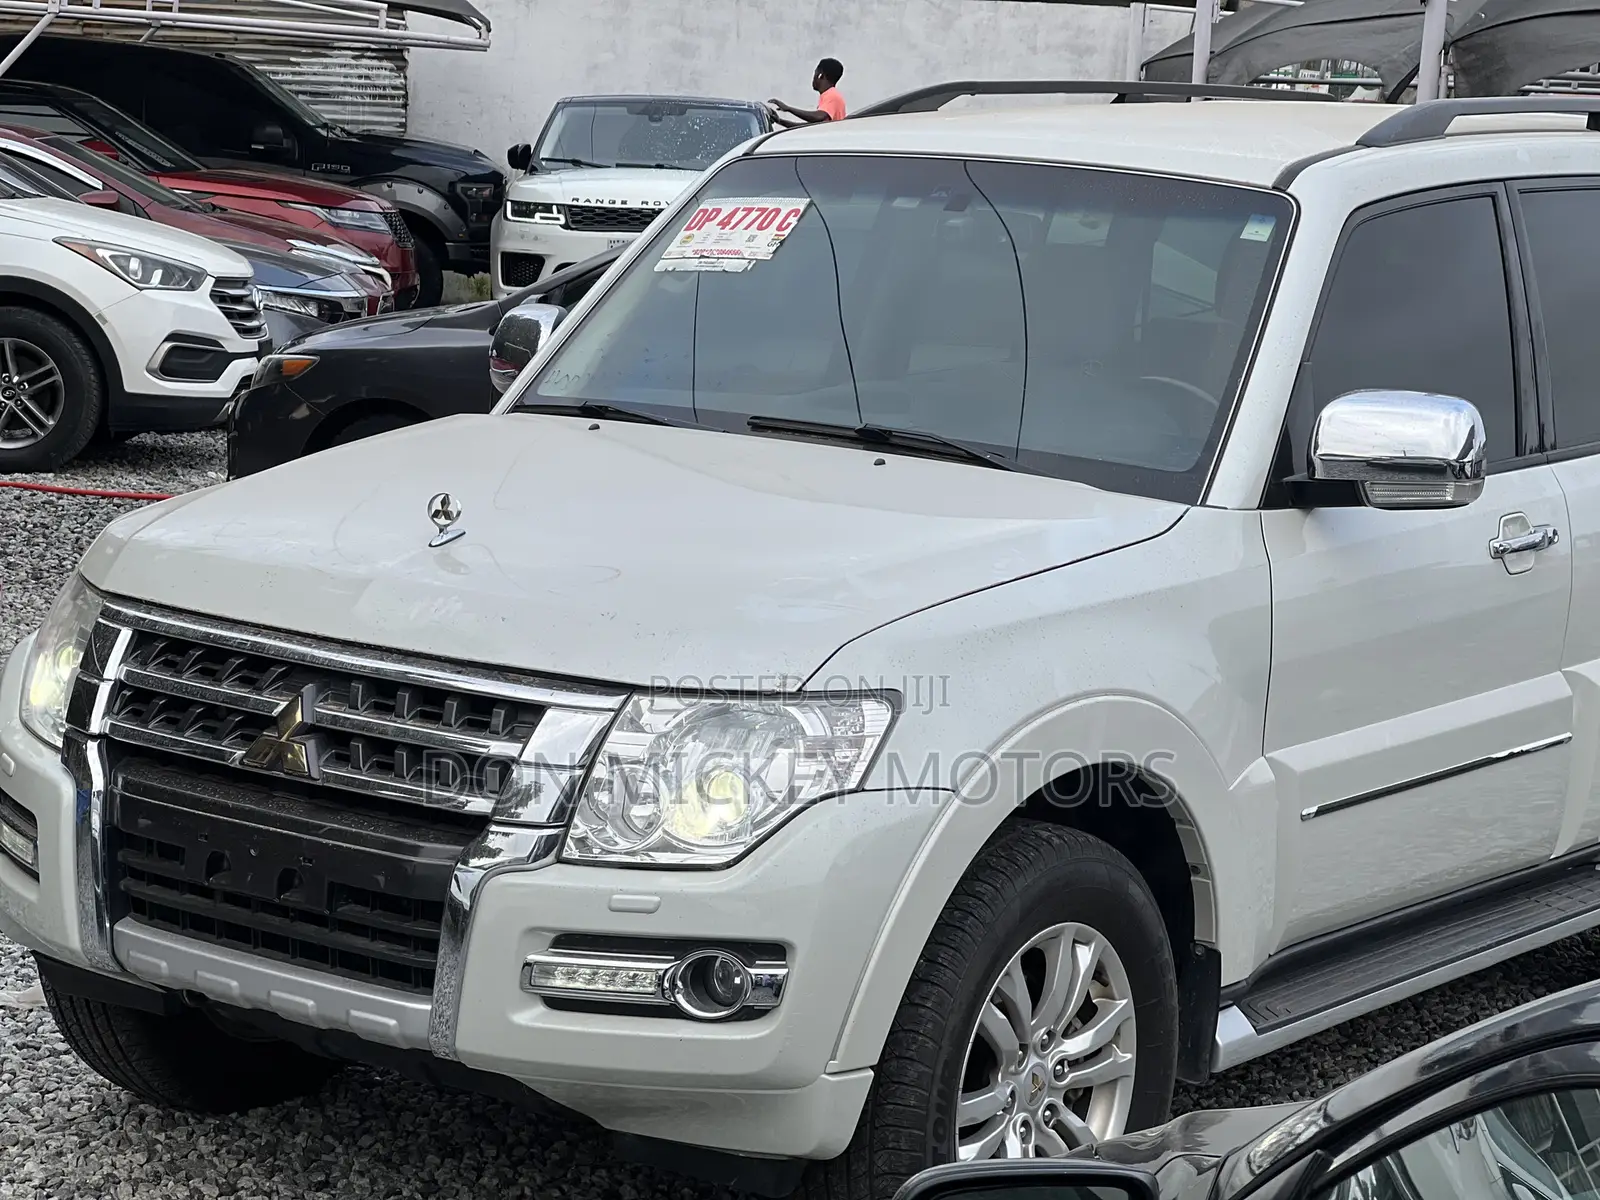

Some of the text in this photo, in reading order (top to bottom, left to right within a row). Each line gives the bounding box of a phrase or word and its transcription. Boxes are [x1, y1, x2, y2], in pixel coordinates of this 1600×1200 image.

[571, 197, 629, 205] RANGE
[684, 206, 801, 232] DP 4770 C
